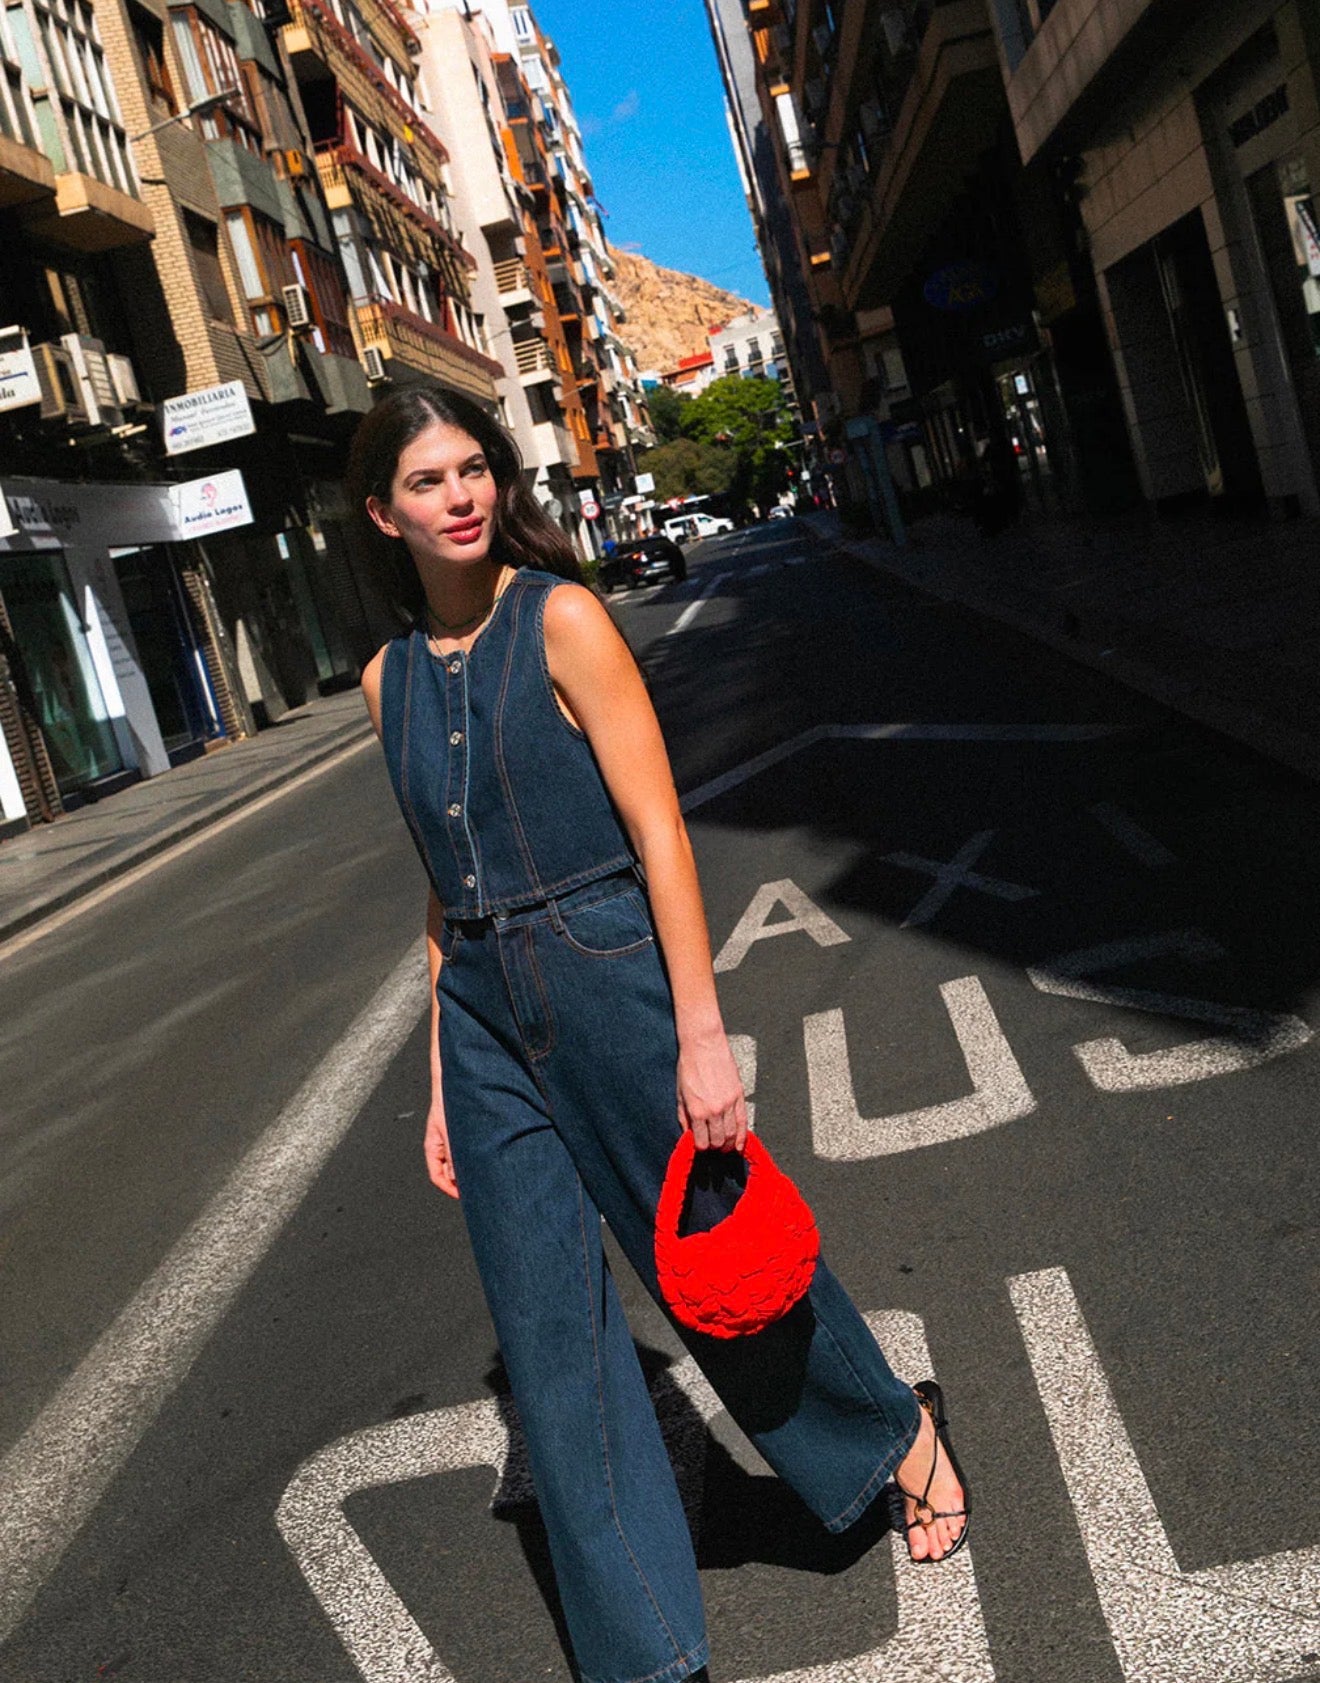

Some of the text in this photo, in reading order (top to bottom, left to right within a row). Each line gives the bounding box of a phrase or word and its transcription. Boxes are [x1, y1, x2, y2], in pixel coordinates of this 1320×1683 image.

[164, 387, 236, 414] INMOBILIARIA
[185, 511, 212, 523] Audio
[214, 504, 243, 515] Lagos
